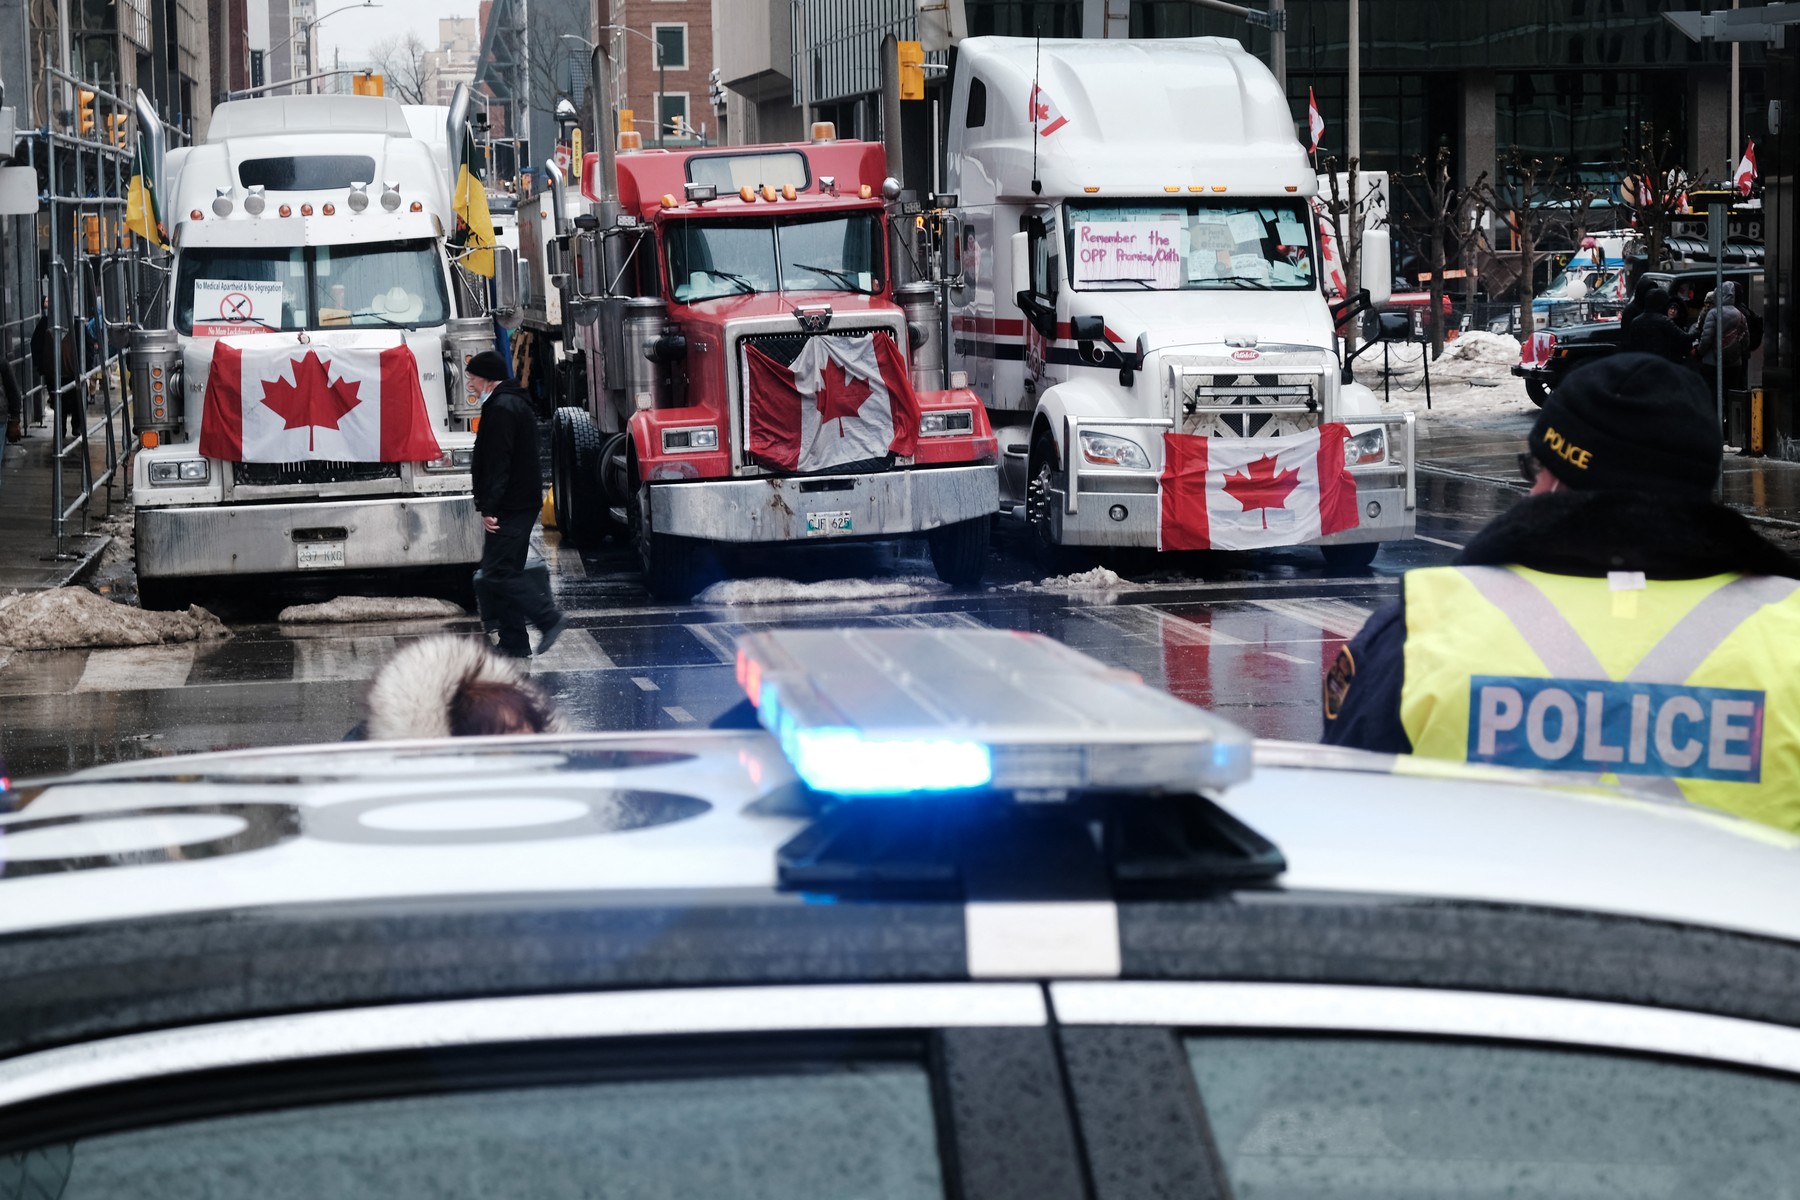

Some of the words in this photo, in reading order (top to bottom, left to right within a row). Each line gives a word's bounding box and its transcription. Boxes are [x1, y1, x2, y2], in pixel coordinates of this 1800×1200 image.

[1081, 226, 1137, 243] Remember
[1149, 230, 1170, 246] the
[1080, 249, 1107, 263] OPP
[196, 281, 202, 289] No
[203, 282, 220, 290] Medical
[221, 283, 242, 291] Apartheid
[255, 283, 281, 294] Segregation
[208, 327, 215, 335] No
[1544, 427, 1593, 469] POLICE
[808, 518, 826, 530] CJF
[832, 517, 850, 529] 625
[1477, 686, 1755, 771] POLICE
